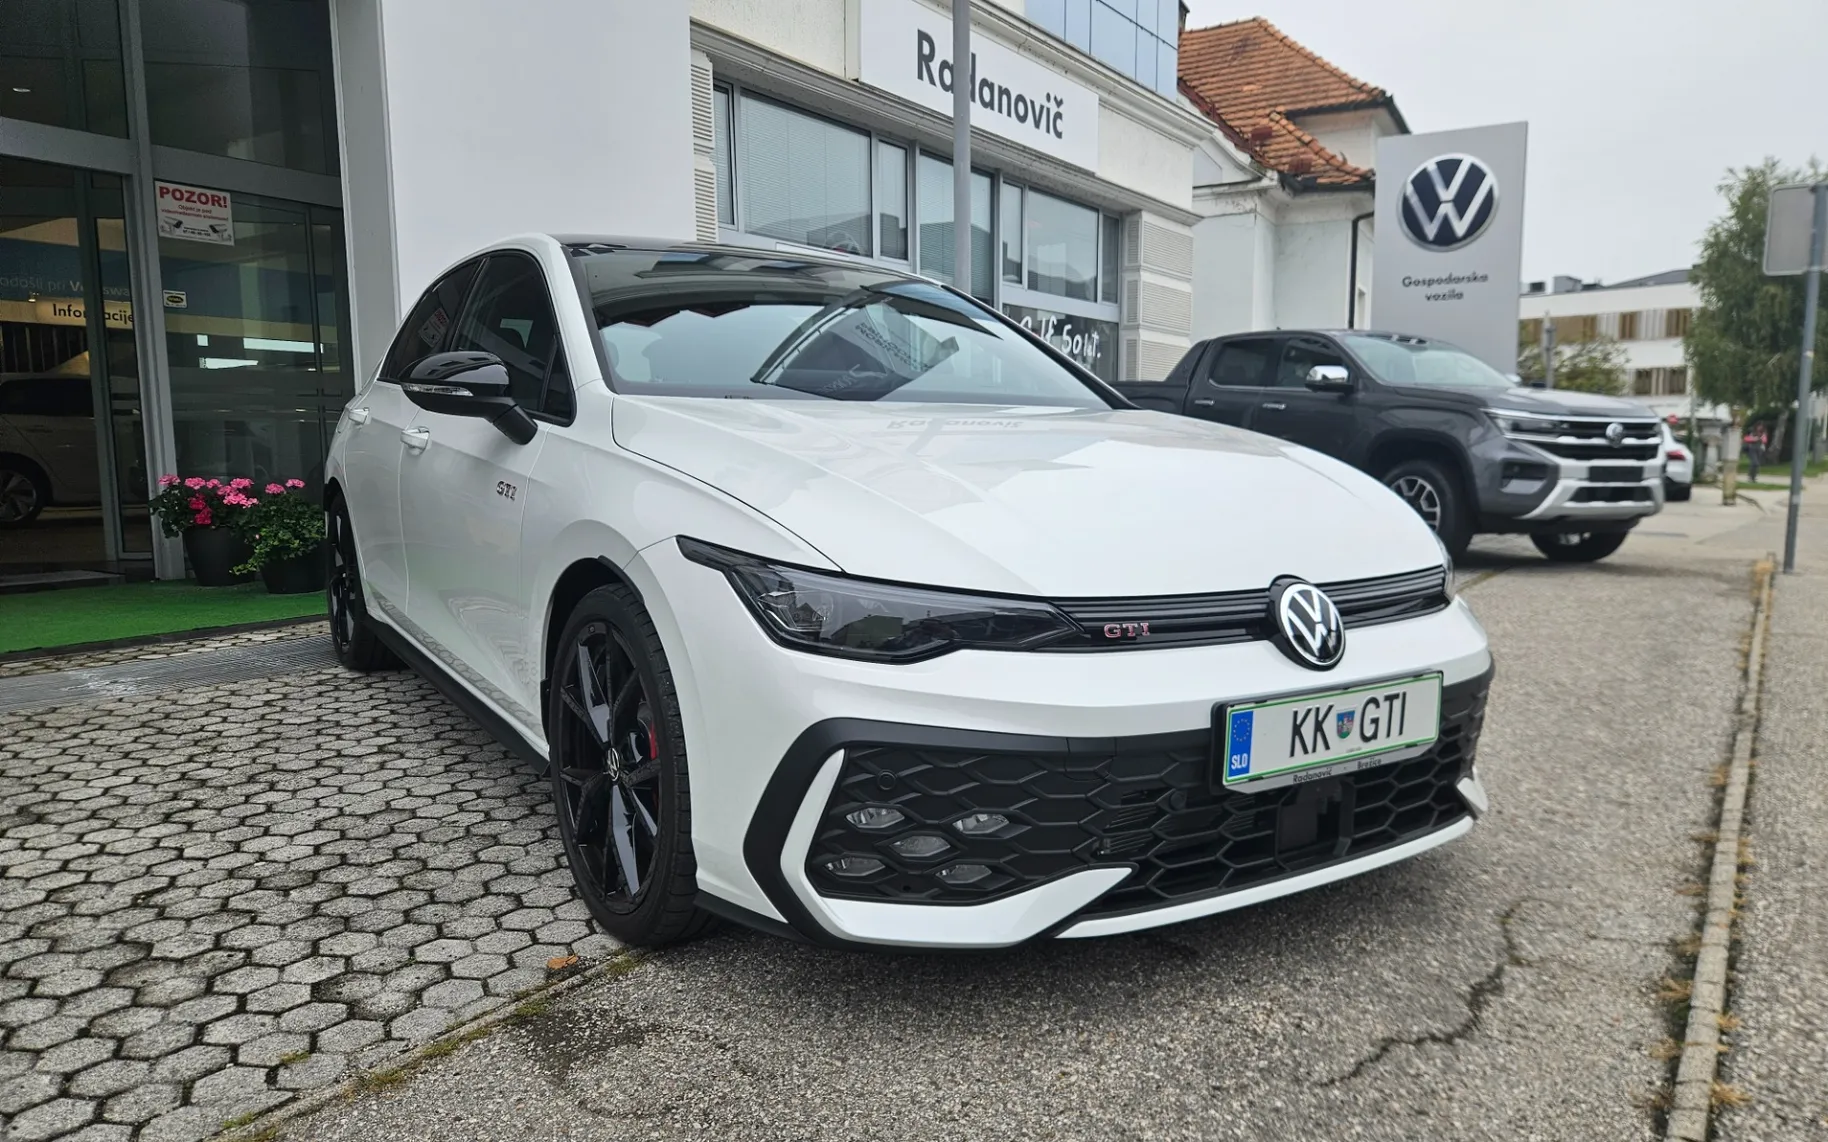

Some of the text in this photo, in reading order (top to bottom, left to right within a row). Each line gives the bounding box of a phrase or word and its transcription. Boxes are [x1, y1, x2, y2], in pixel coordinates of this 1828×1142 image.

[158, 185, 228, 209] POZOR!
[1402, 272, 1488, 287] Gospodarska
[1425, 289, 1464, 301] vozila
[1104, 622, 1150, 638] GTI
[1289, 691, 1407, 758] KK GTI
[1231, 753, 1249, 770] SLO
[1292, 757, 1382, 784] Radanovič Brežice
